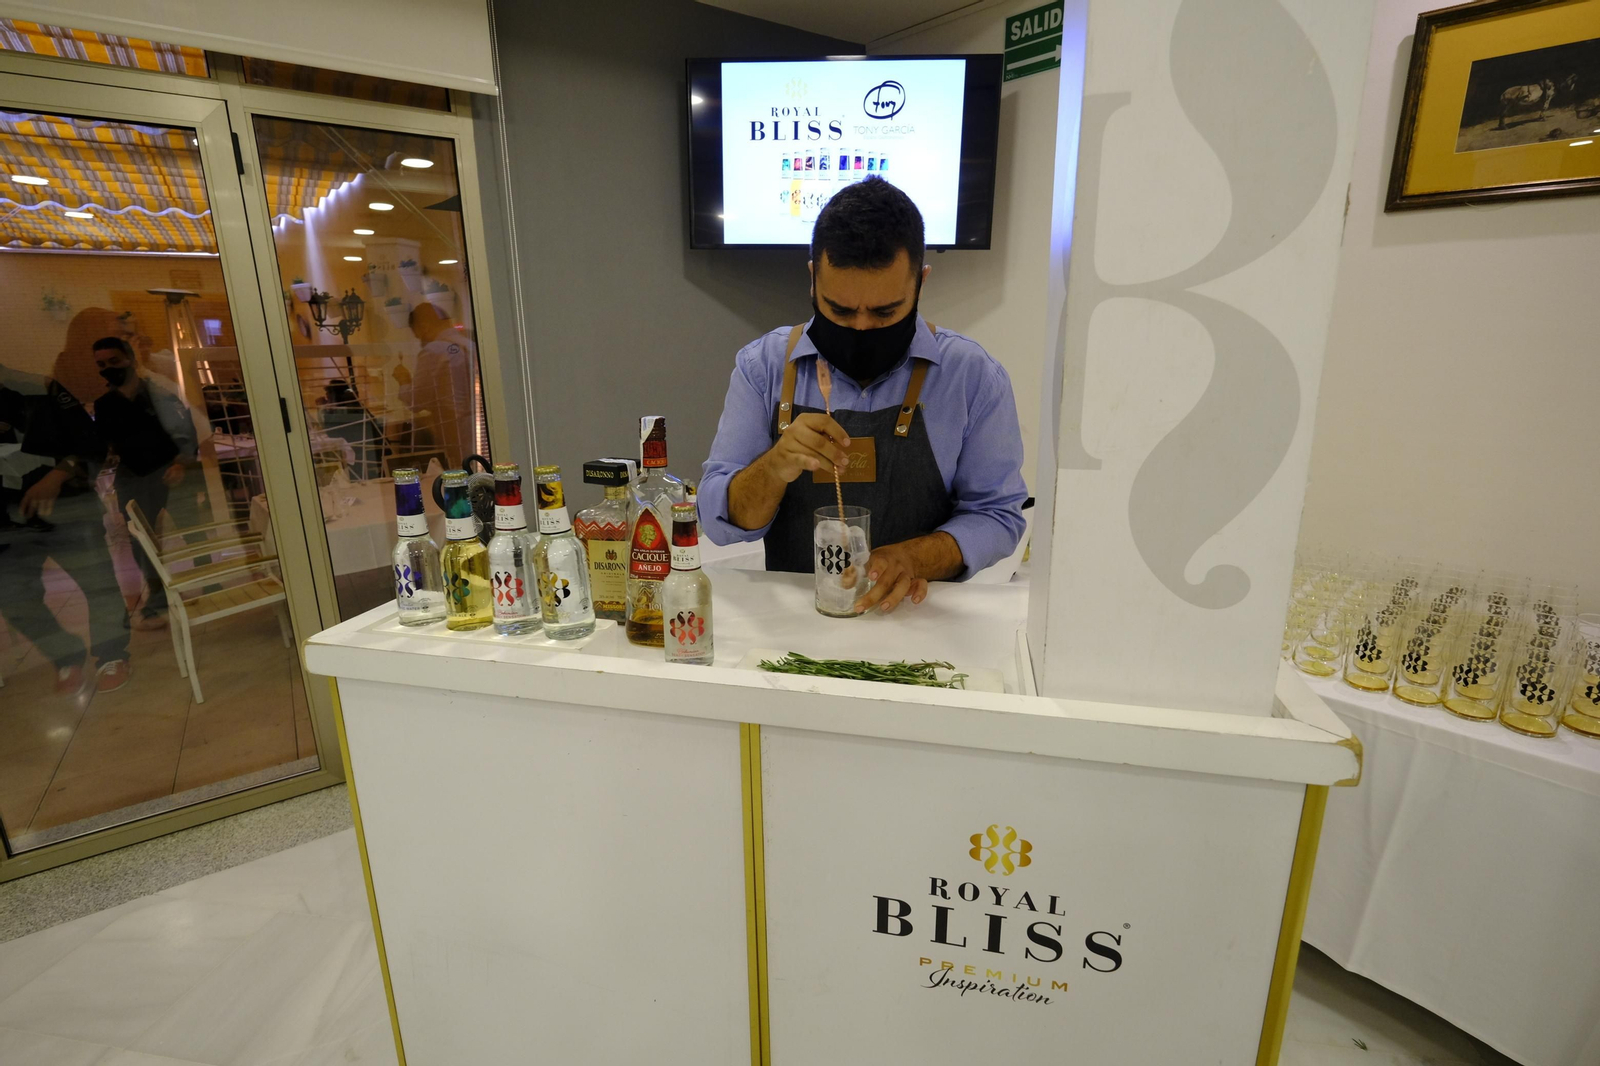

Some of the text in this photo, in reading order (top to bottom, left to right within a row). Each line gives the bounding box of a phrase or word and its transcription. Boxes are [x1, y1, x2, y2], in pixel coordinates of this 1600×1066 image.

[1010, 8, 1063, 41] SALID
[770, 106, 822, 117] ROYAL
[750, 120, 843, 141] BLISS
[853, 125, 879, 135] TONY
[585, 469, 614, 479] DISARONNO
[632, 552, 668, 562] CACIQUE
[594, 562, 626, 571] DISARONN
[638, 563, 662, 571] AÑEJO
[928, 876, 1066, 917] ROYAL
[872, 895, 1123, 973] BLISS
[919, 956, 1069, 993] PREMIUM
[920, 965, 1054, 1006] Inspiration
